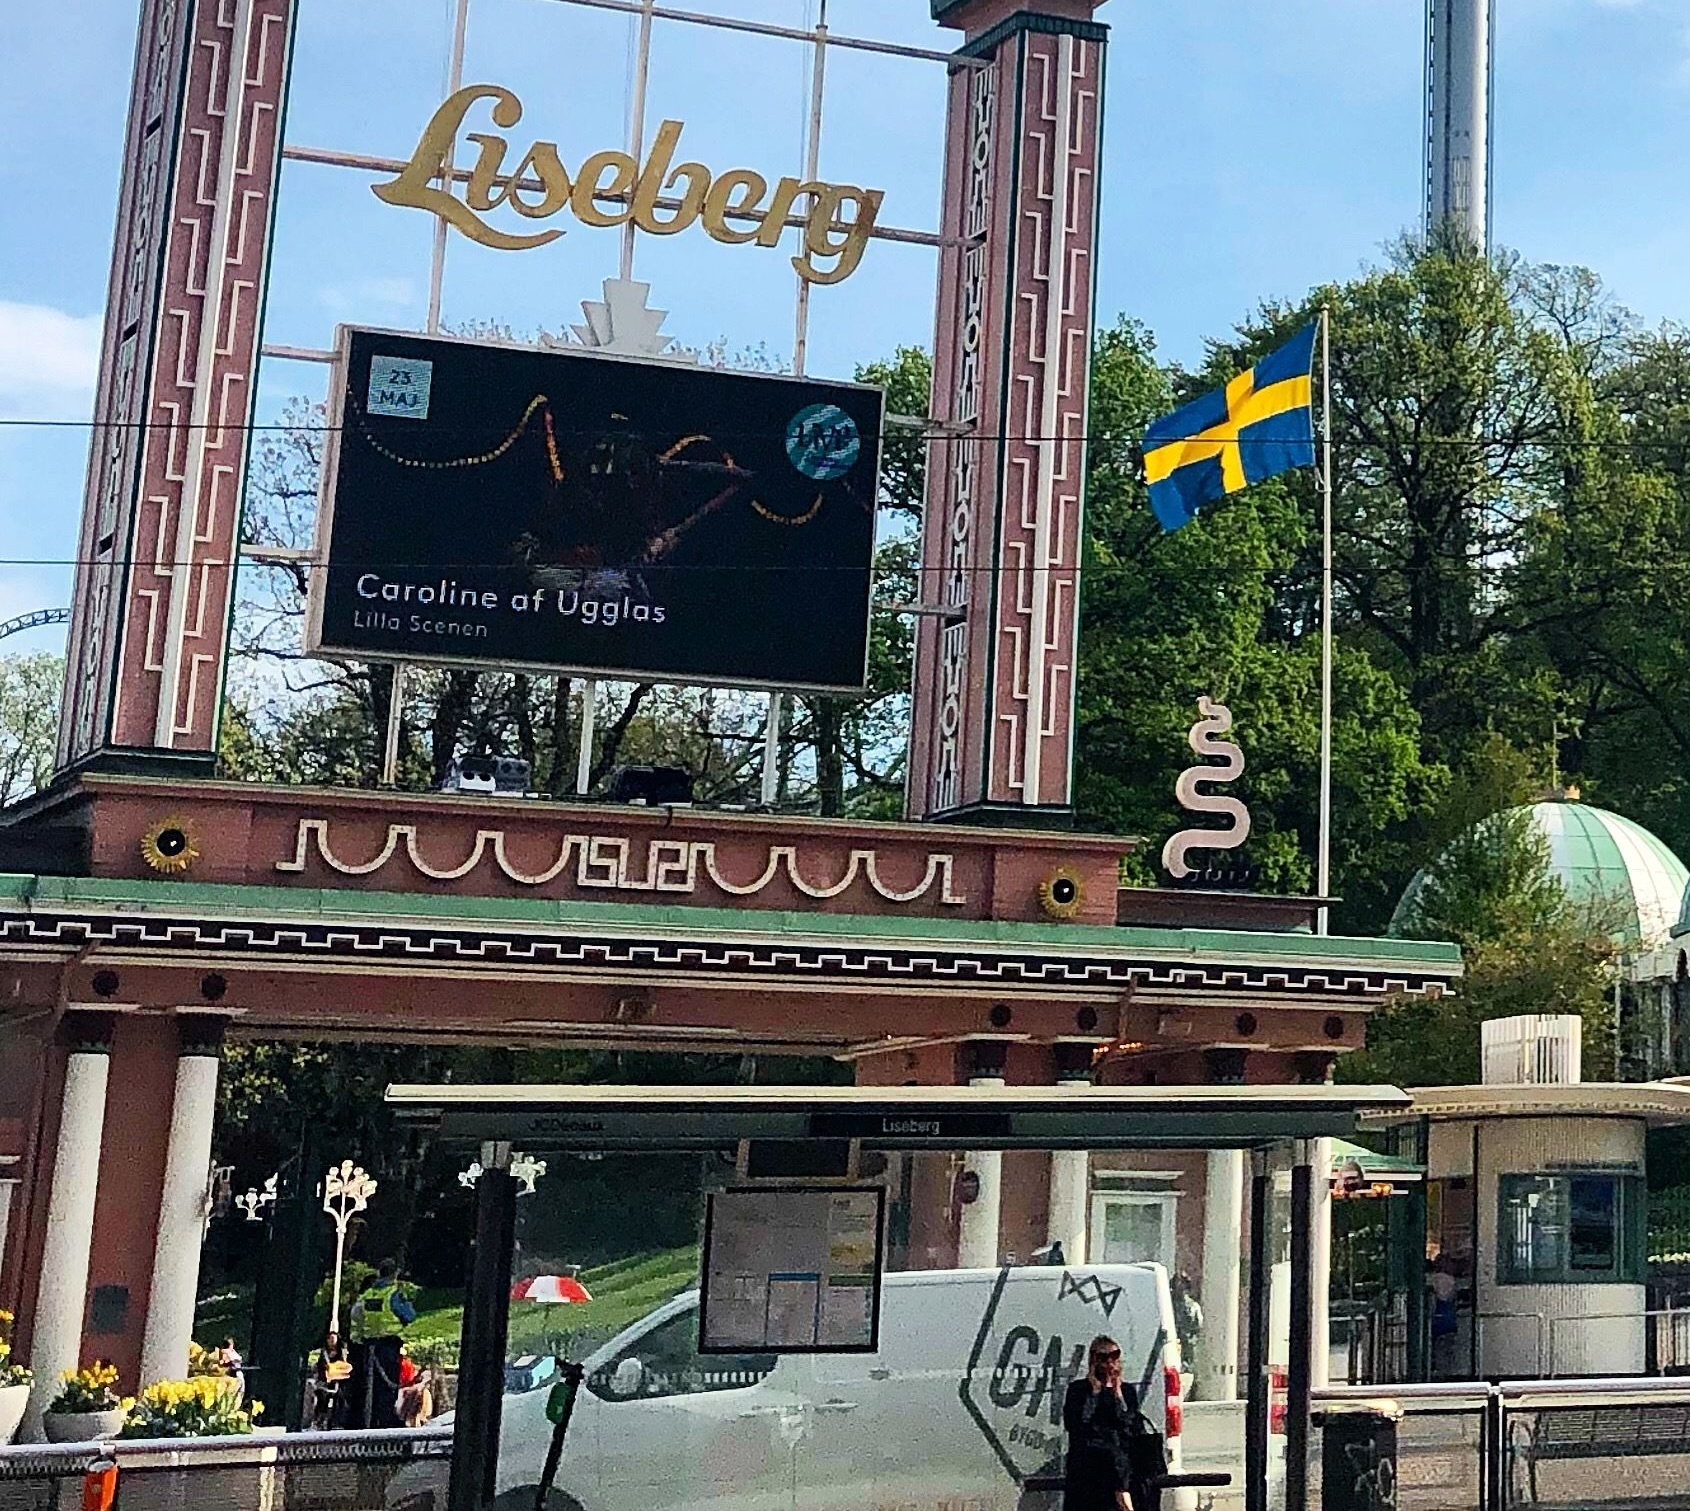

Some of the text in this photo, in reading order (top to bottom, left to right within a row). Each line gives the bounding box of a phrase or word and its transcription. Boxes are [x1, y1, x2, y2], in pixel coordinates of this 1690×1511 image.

[372, 84, 886, 285] Liseberg
[388, 368, 412, 386] 23
[378, 390, 418, 409] MAJ
[356, 572, 667, 627] Caroline af Ugglas
[353, 610, 488, 637] Lilla Scenen
[881, 1117, 940, 1135] Liseberg
